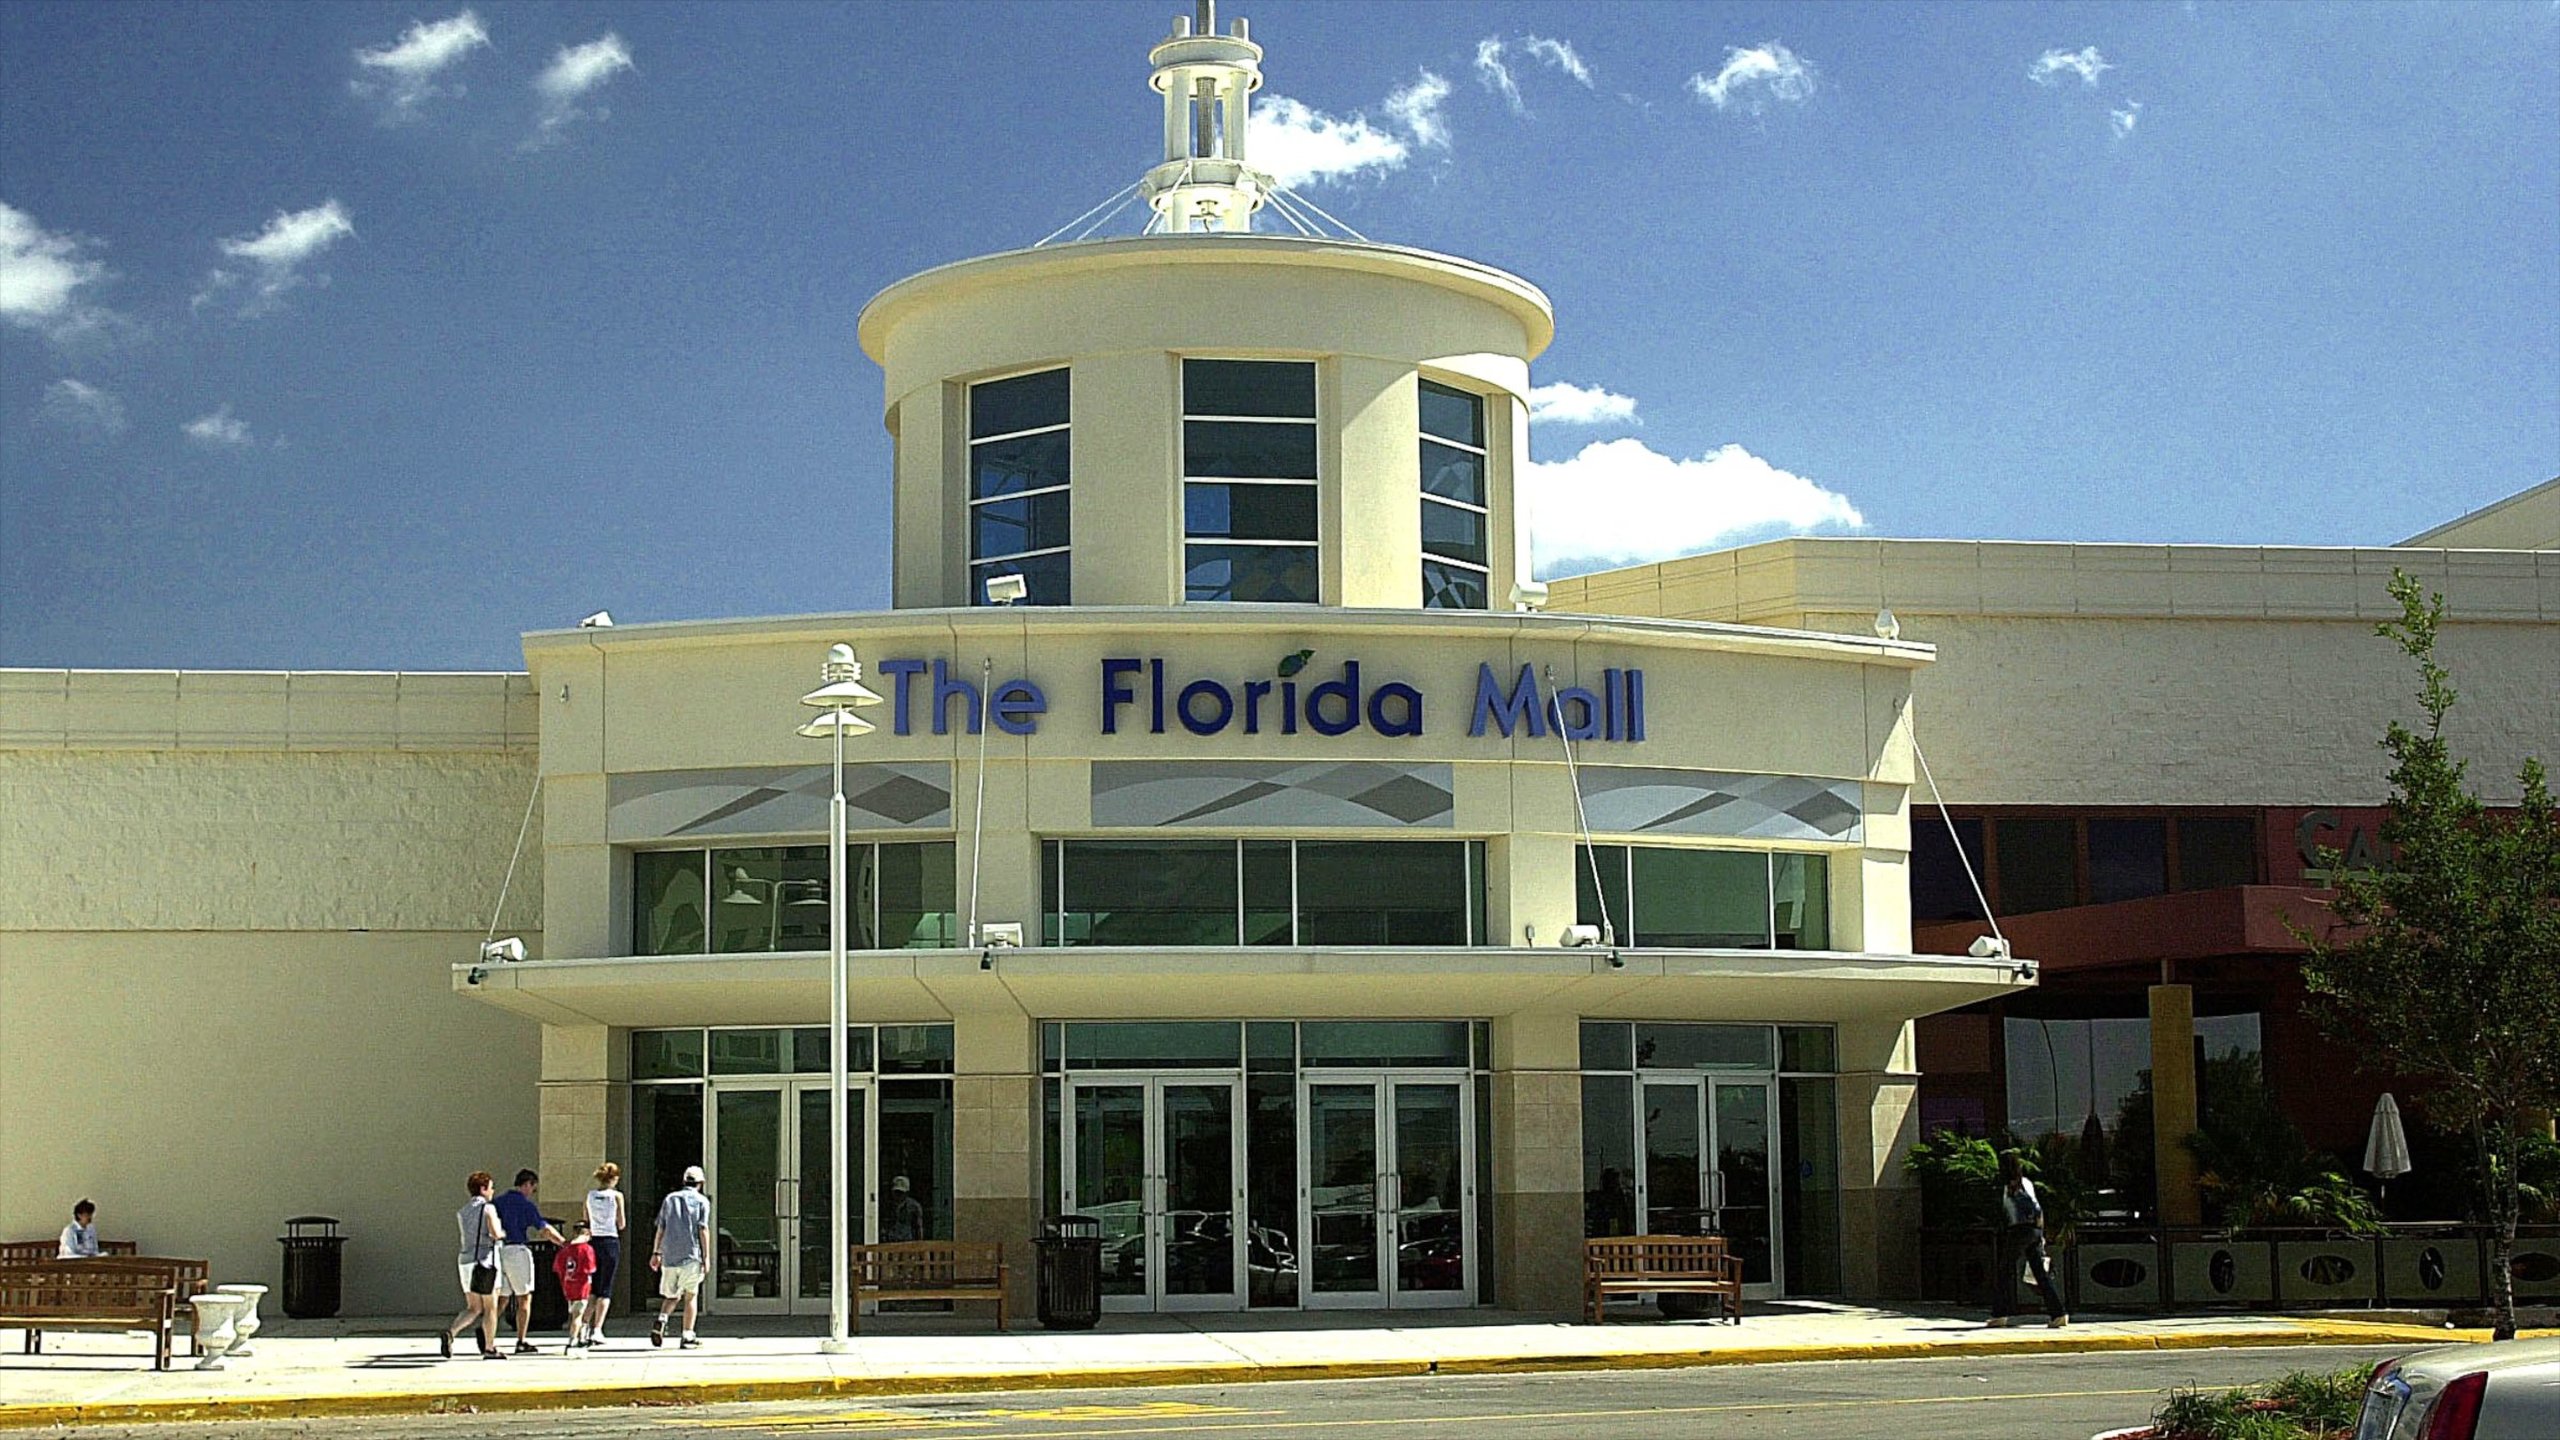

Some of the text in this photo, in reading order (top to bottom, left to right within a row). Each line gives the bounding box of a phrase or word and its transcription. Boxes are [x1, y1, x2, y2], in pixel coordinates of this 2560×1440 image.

[878, 651, 1646, 742] The Florida Mall
